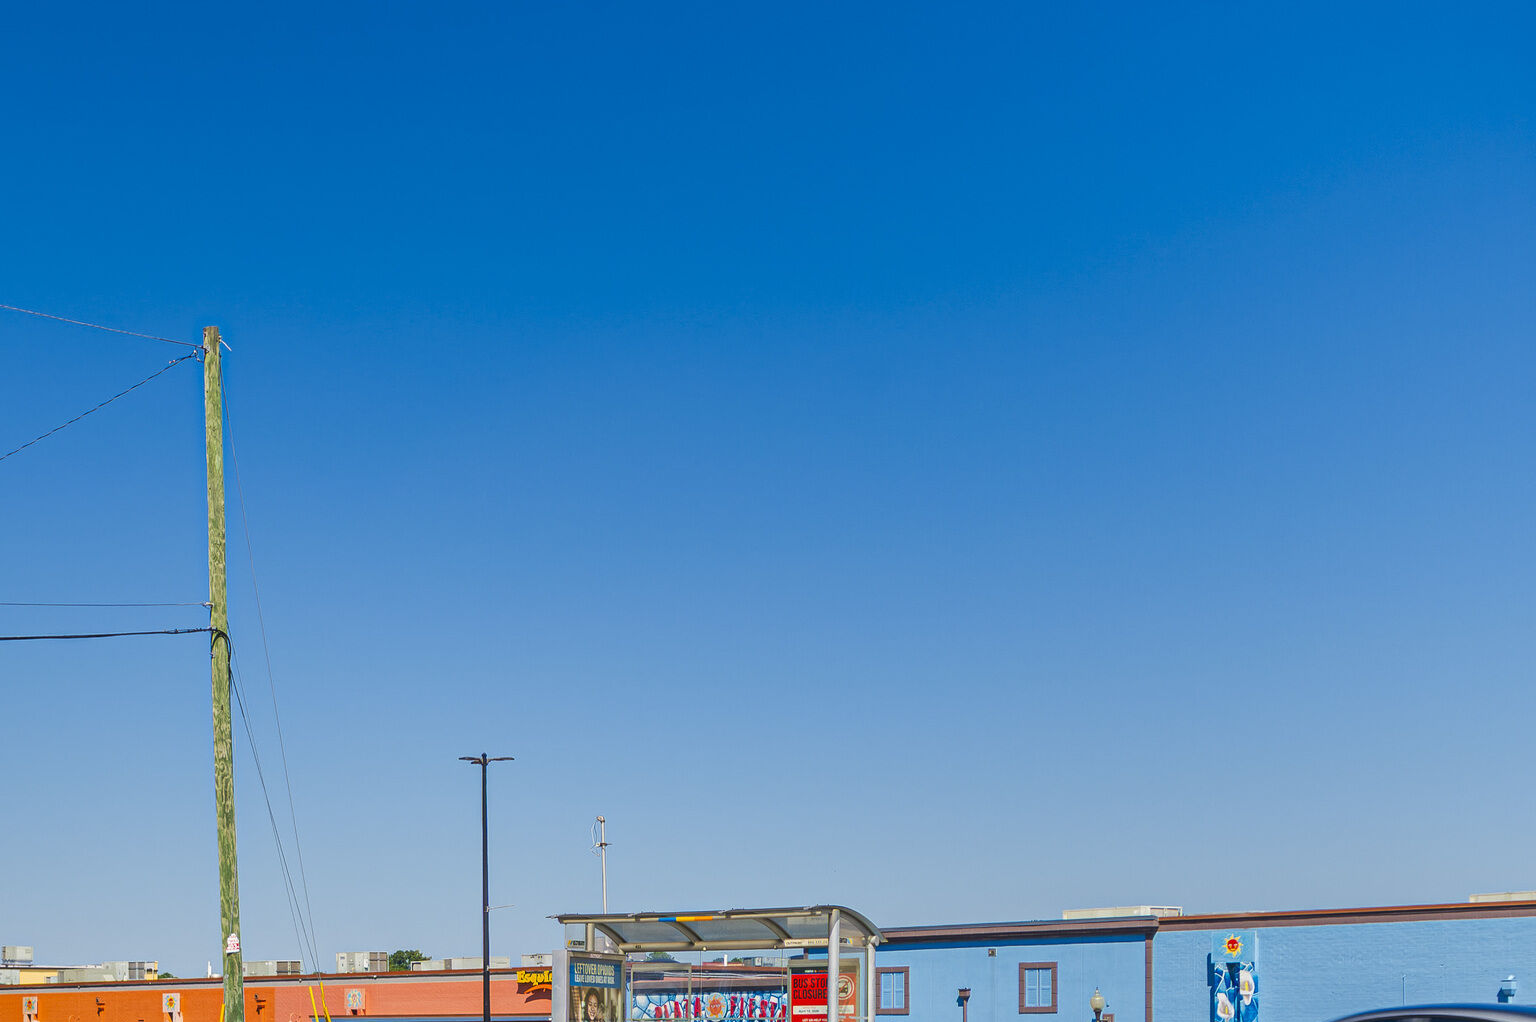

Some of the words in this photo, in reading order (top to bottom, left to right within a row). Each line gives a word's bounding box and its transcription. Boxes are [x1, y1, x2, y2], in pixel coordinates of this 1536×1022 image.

[574, 962, 597, 975] LEFTOVER
[793, 978, 809, 989] BUS
[793, 989, 828, 1000] CLOSURE
